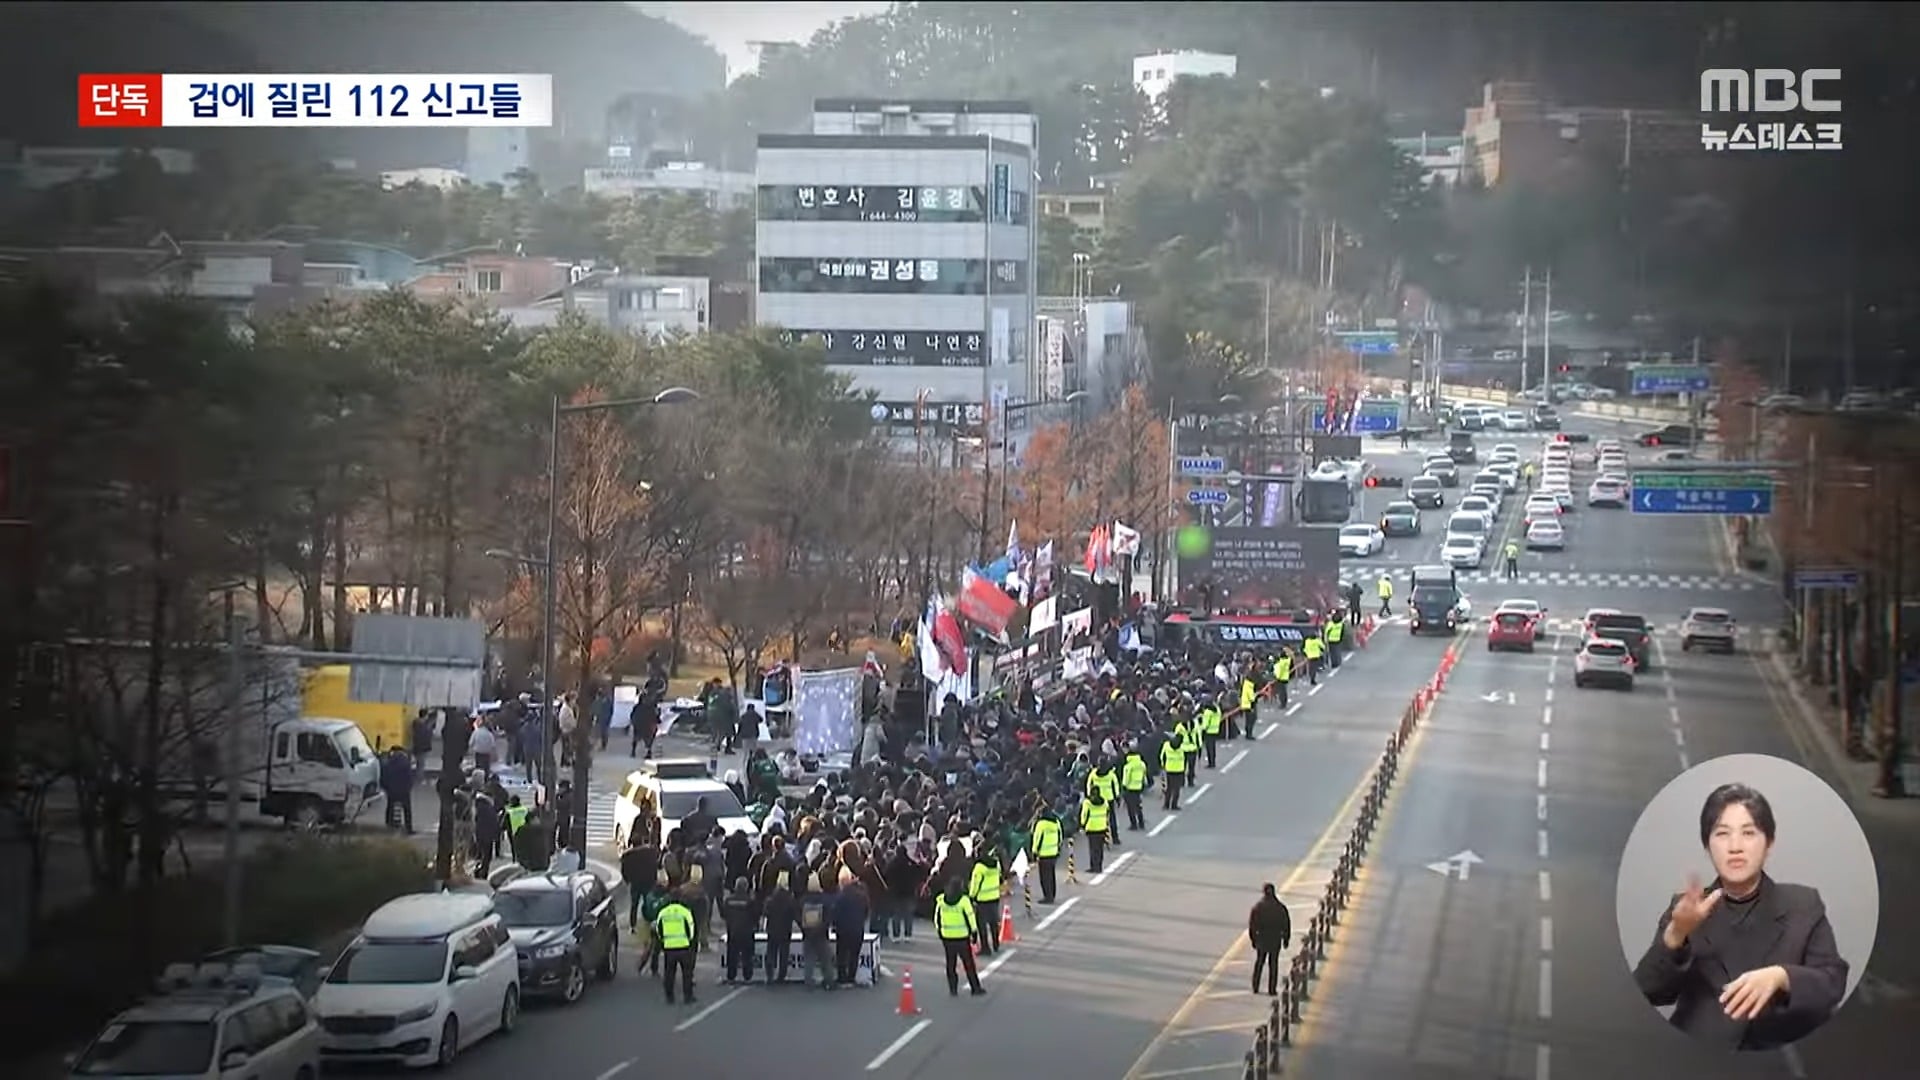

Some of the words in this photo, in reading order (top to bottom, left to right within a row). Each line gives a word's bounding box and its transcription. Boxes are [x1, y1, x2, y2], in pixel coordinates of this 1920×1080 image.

[798, 187, 866, 208] 변호사
[819, 263, 866, 278] 국회의원
[870, 259, 939, 281] 권성동
